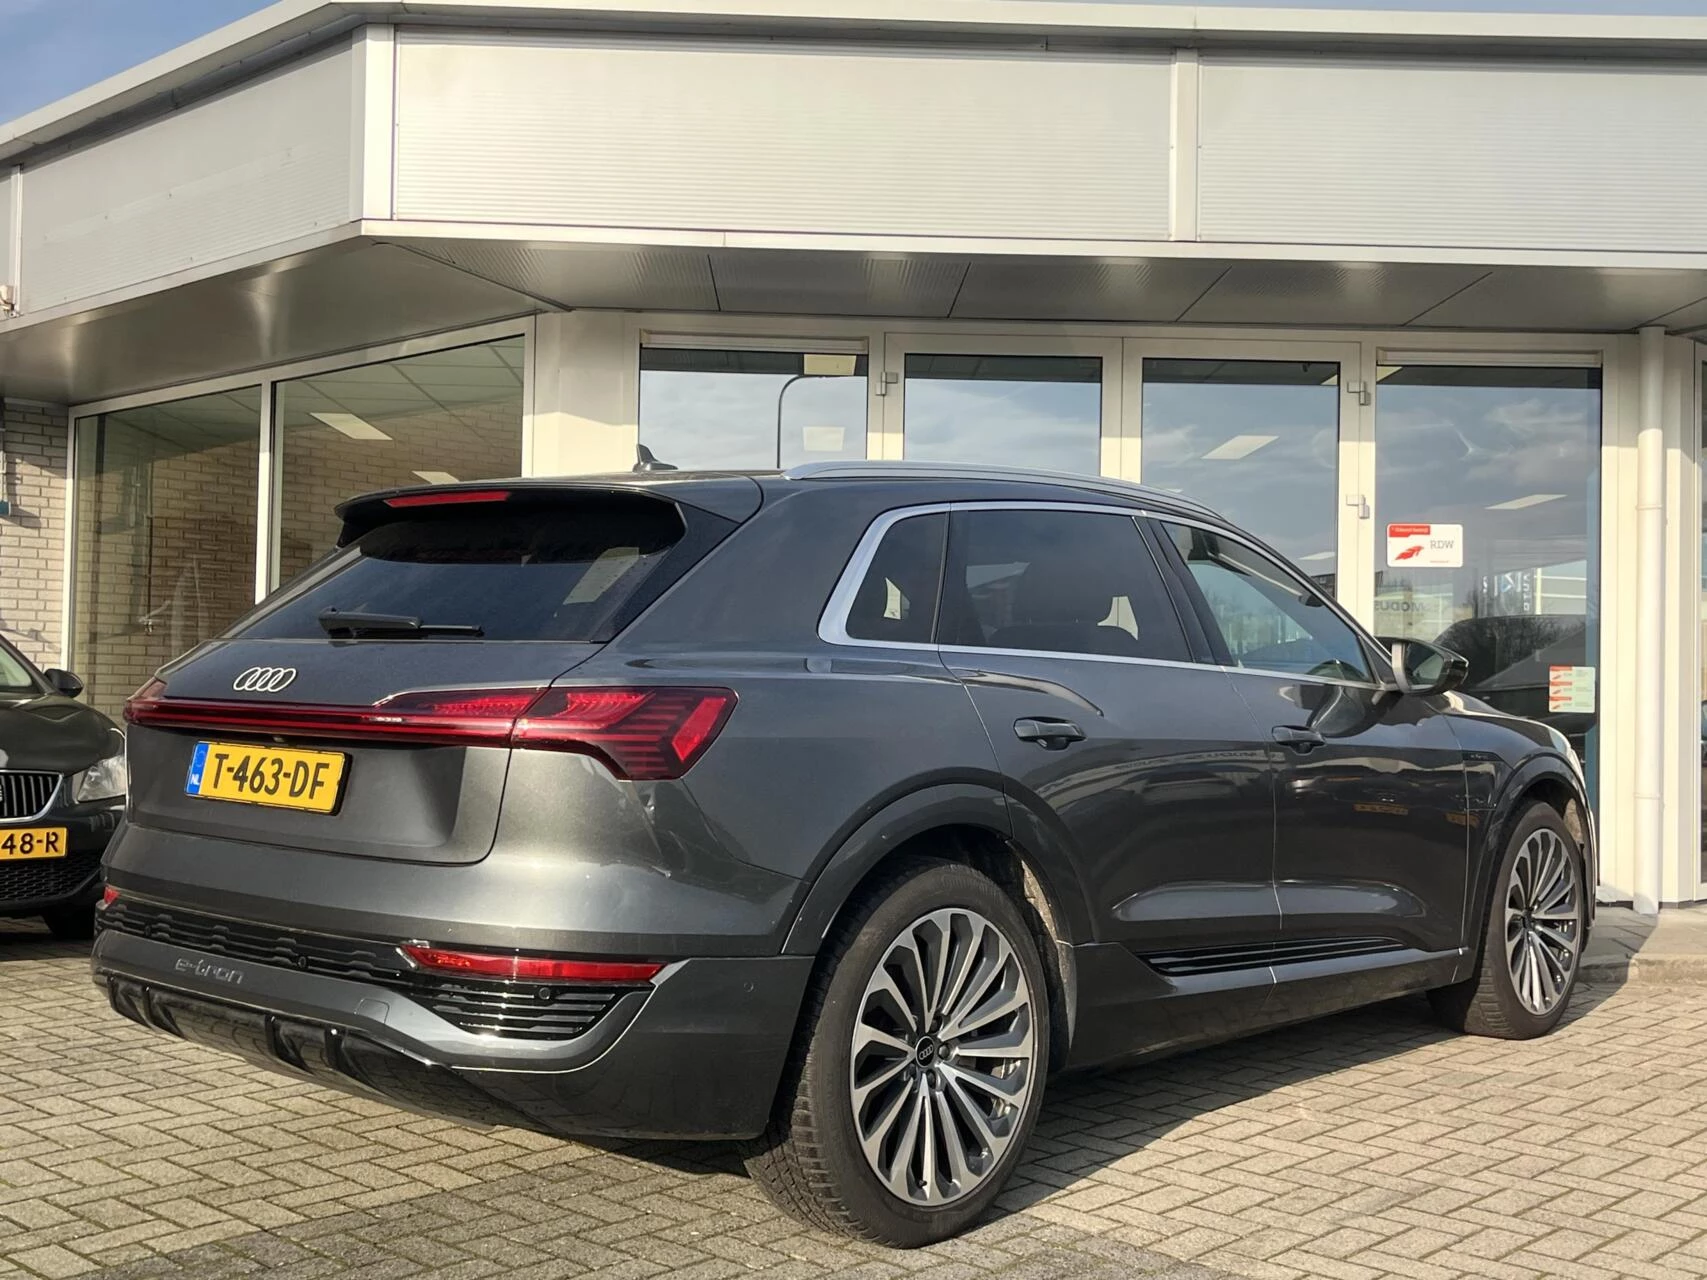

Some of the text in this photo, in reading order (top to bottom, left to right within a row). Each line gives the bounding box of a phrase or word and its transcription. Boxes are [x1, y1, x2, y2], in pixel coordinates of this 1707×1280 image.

[1430, 540, 1454, 549] RDW
[190, 773, 200, 785] NL
[213, 753, 330, 800] T-463-DF
[175, 958, 244, 984] e-tron
